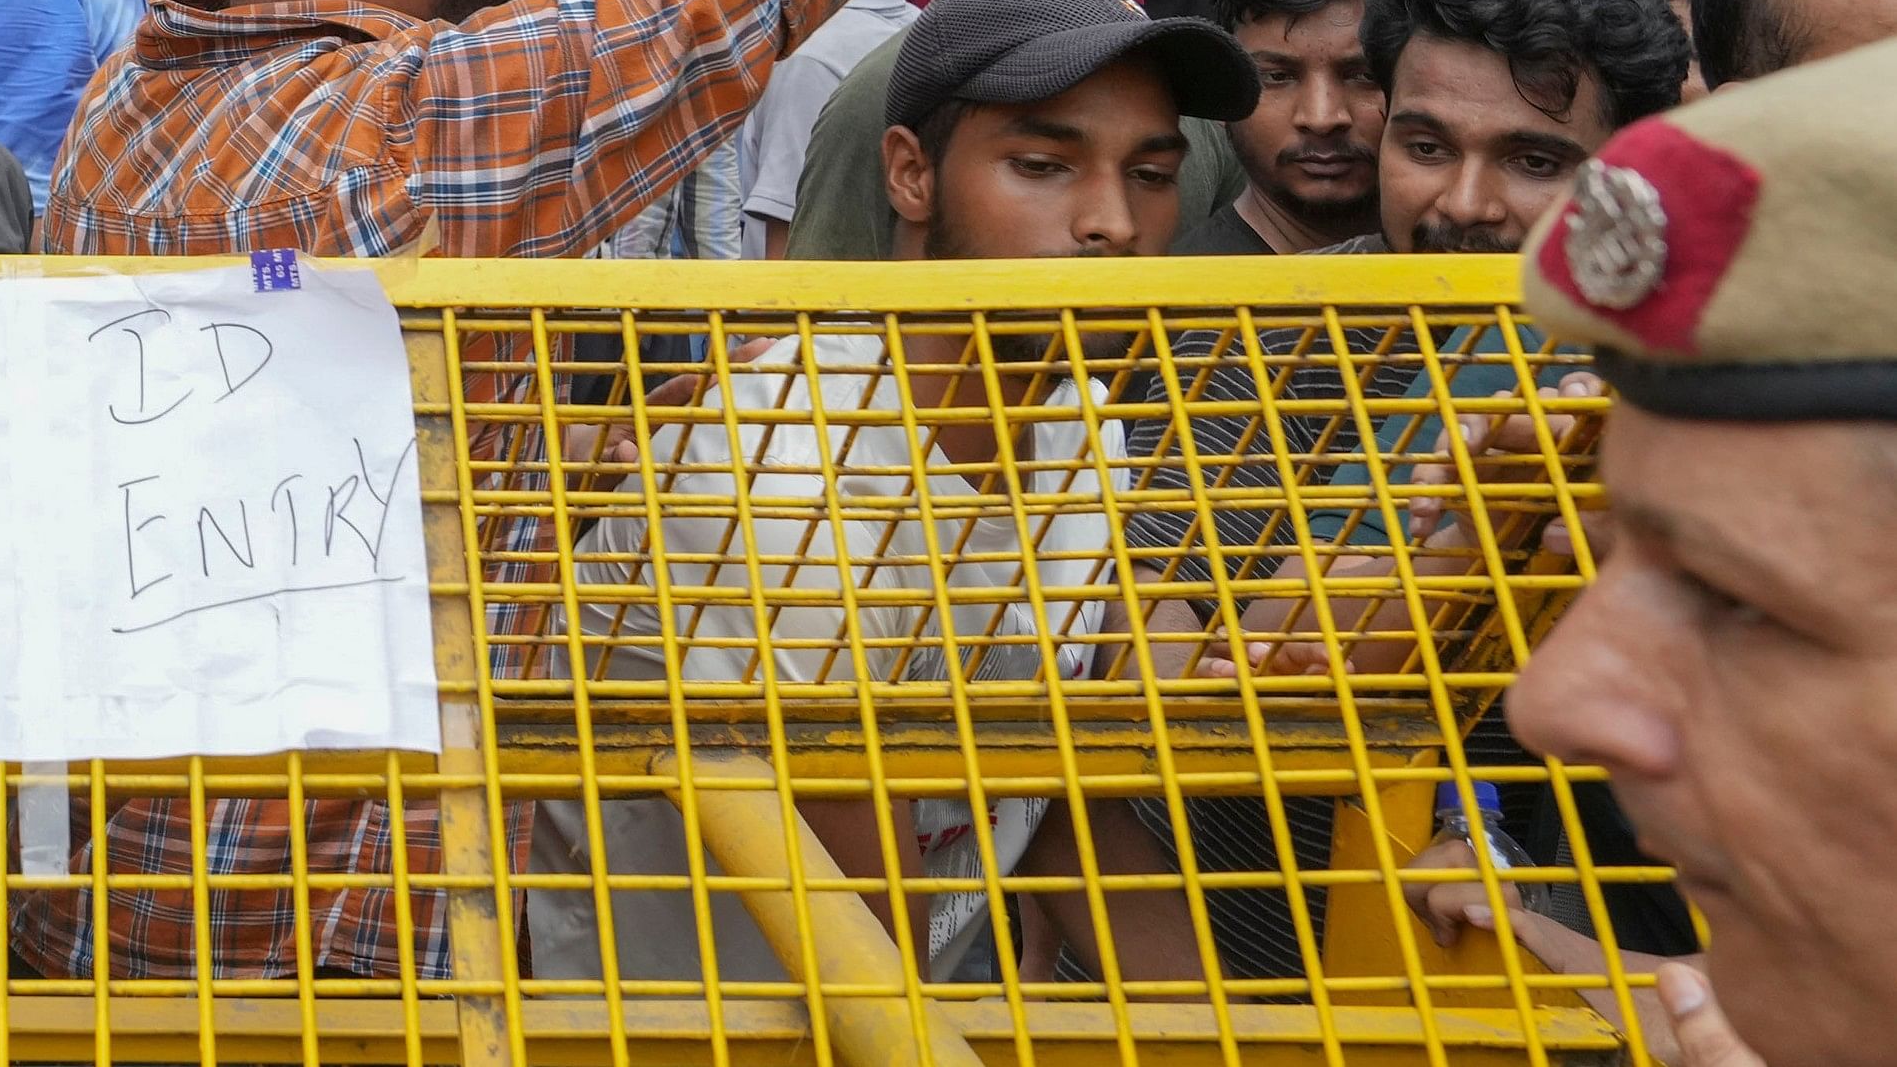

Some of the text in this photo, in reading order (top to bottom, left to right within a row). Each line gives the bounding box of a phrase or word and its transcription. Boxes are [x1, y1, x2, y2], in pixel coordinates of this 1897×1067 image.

[275, 264, 285, 278] 65
[88, 308, 274, 427] ID
[118, 437, 418, 600] ENTRY
